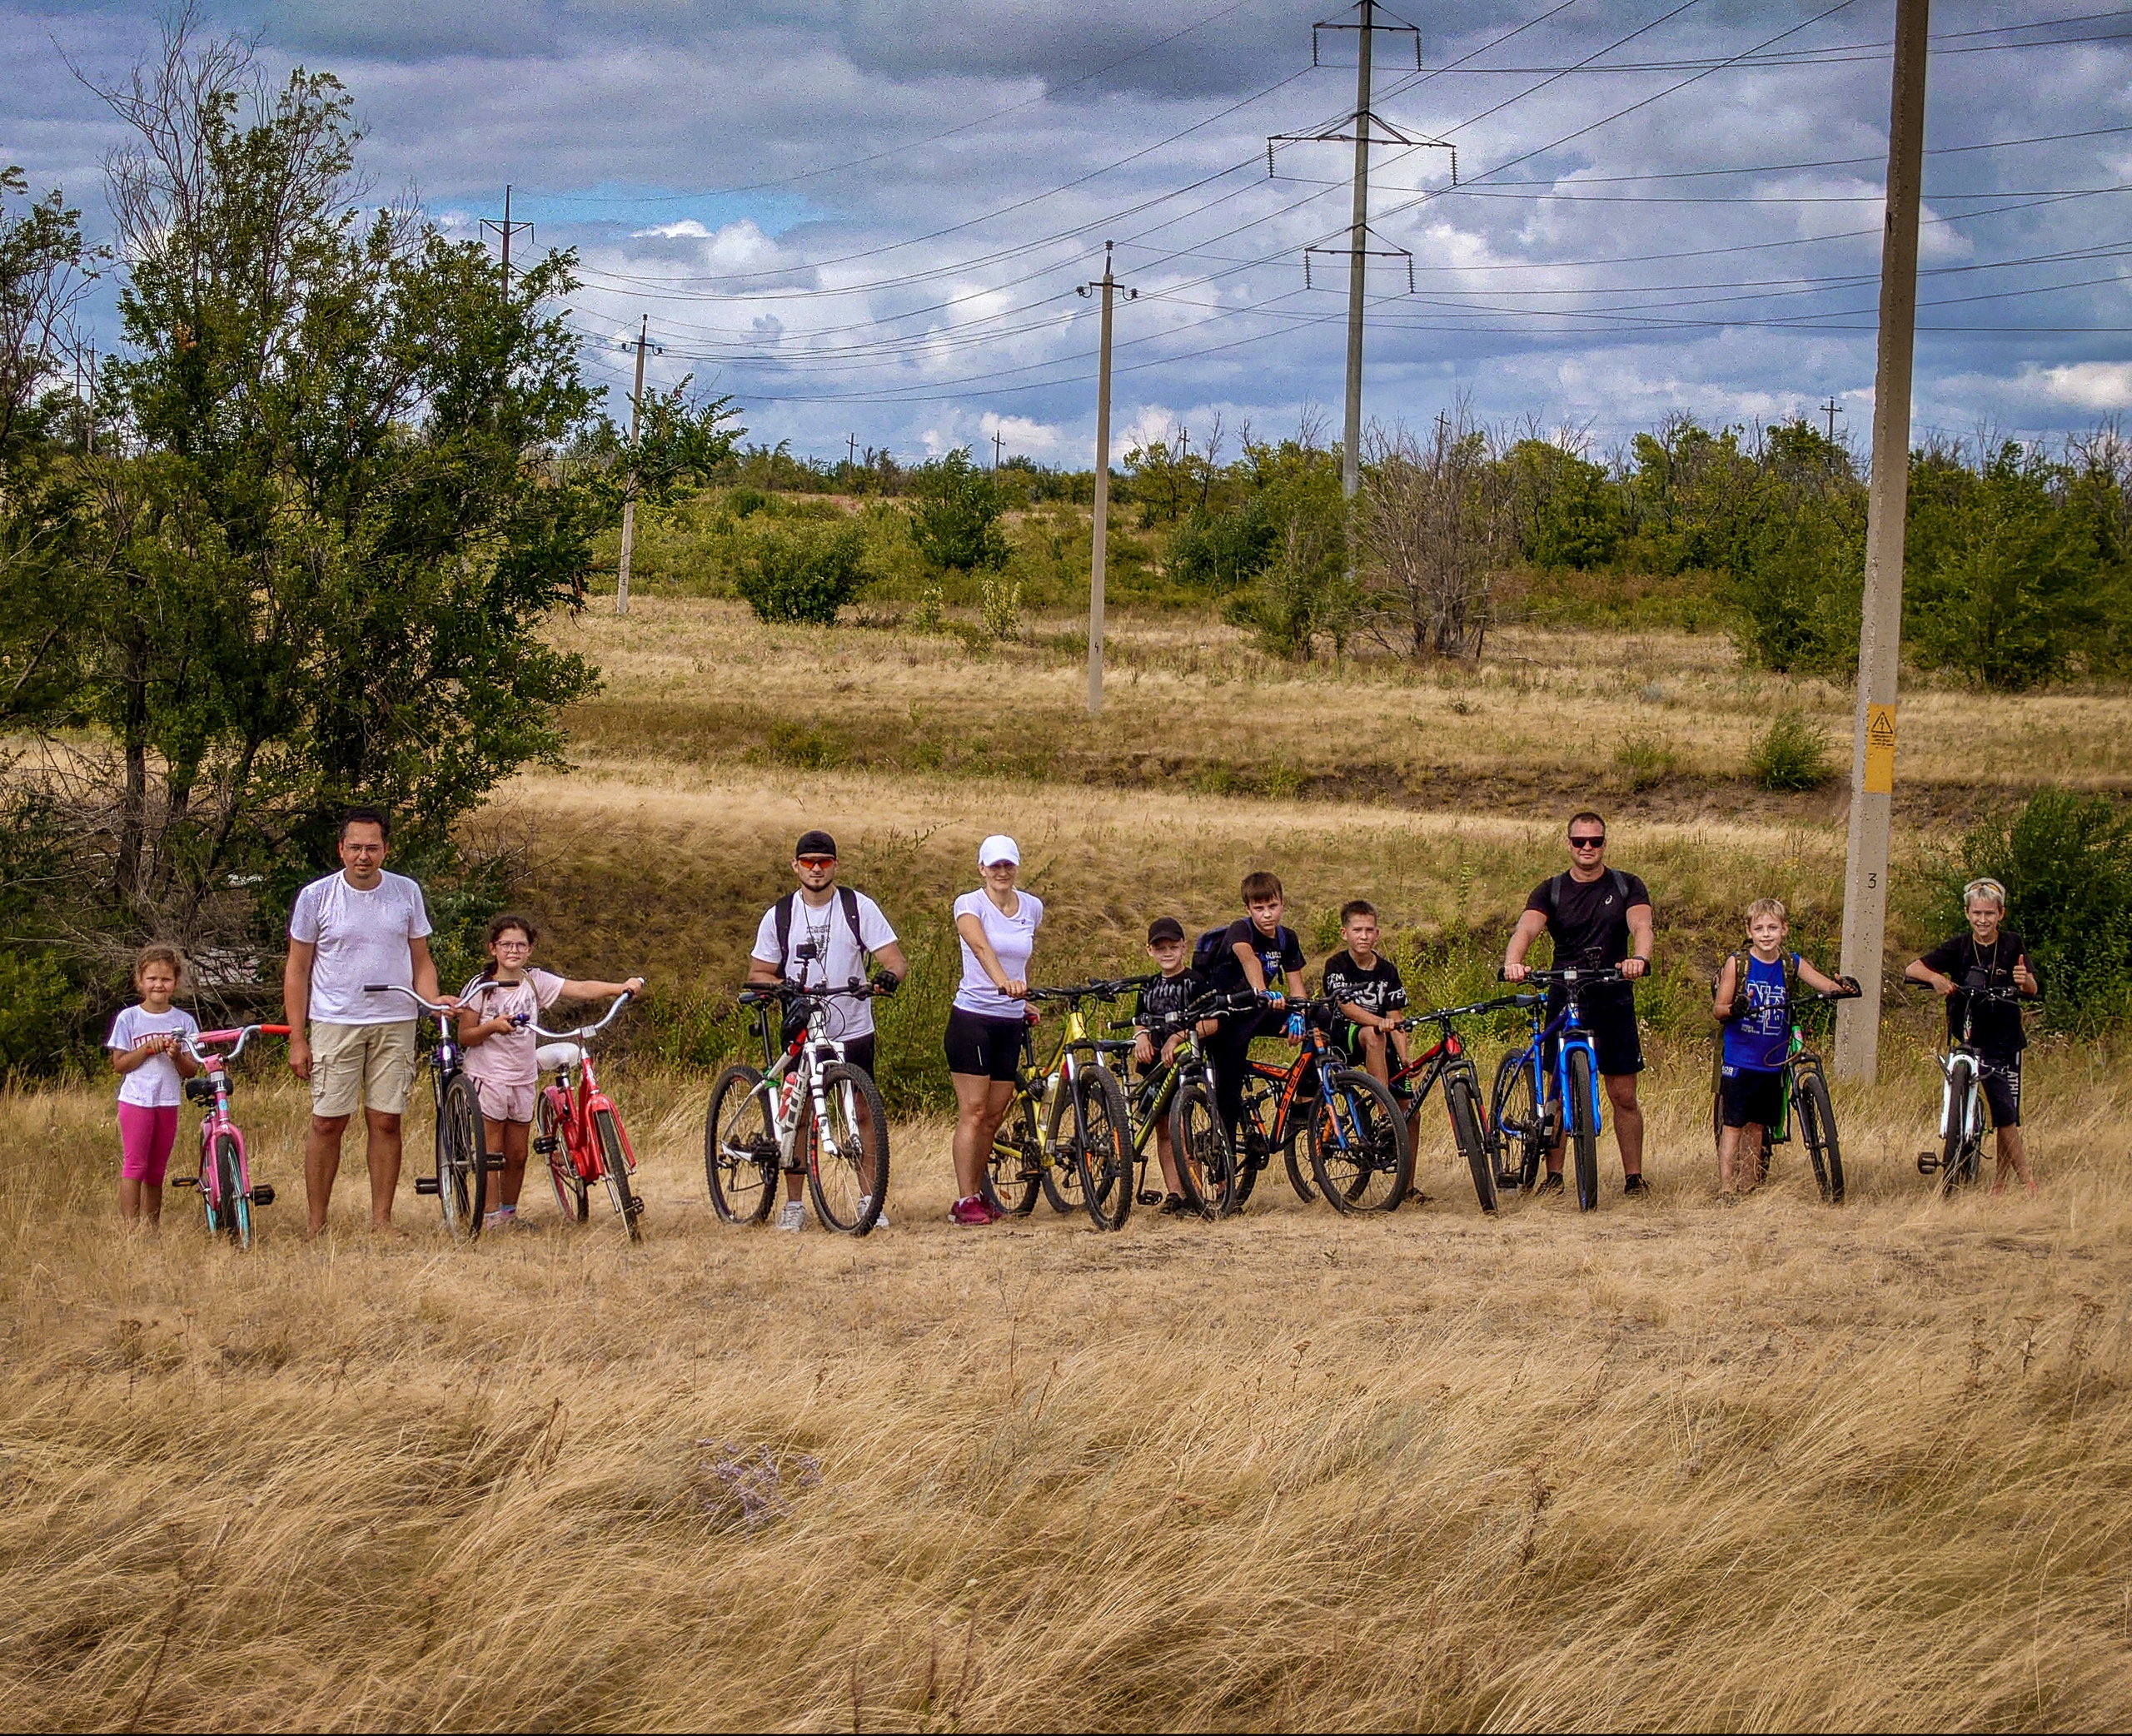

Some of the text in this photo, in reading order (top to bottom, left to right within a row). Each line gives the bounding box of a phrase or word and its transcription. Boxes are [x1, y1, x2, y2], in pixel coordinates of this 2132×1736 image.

[1094, 641, 1099, 654] 4
[1868, 873, 1877, 888] 3
[1280, 1058, 1305, 1112] STELS
